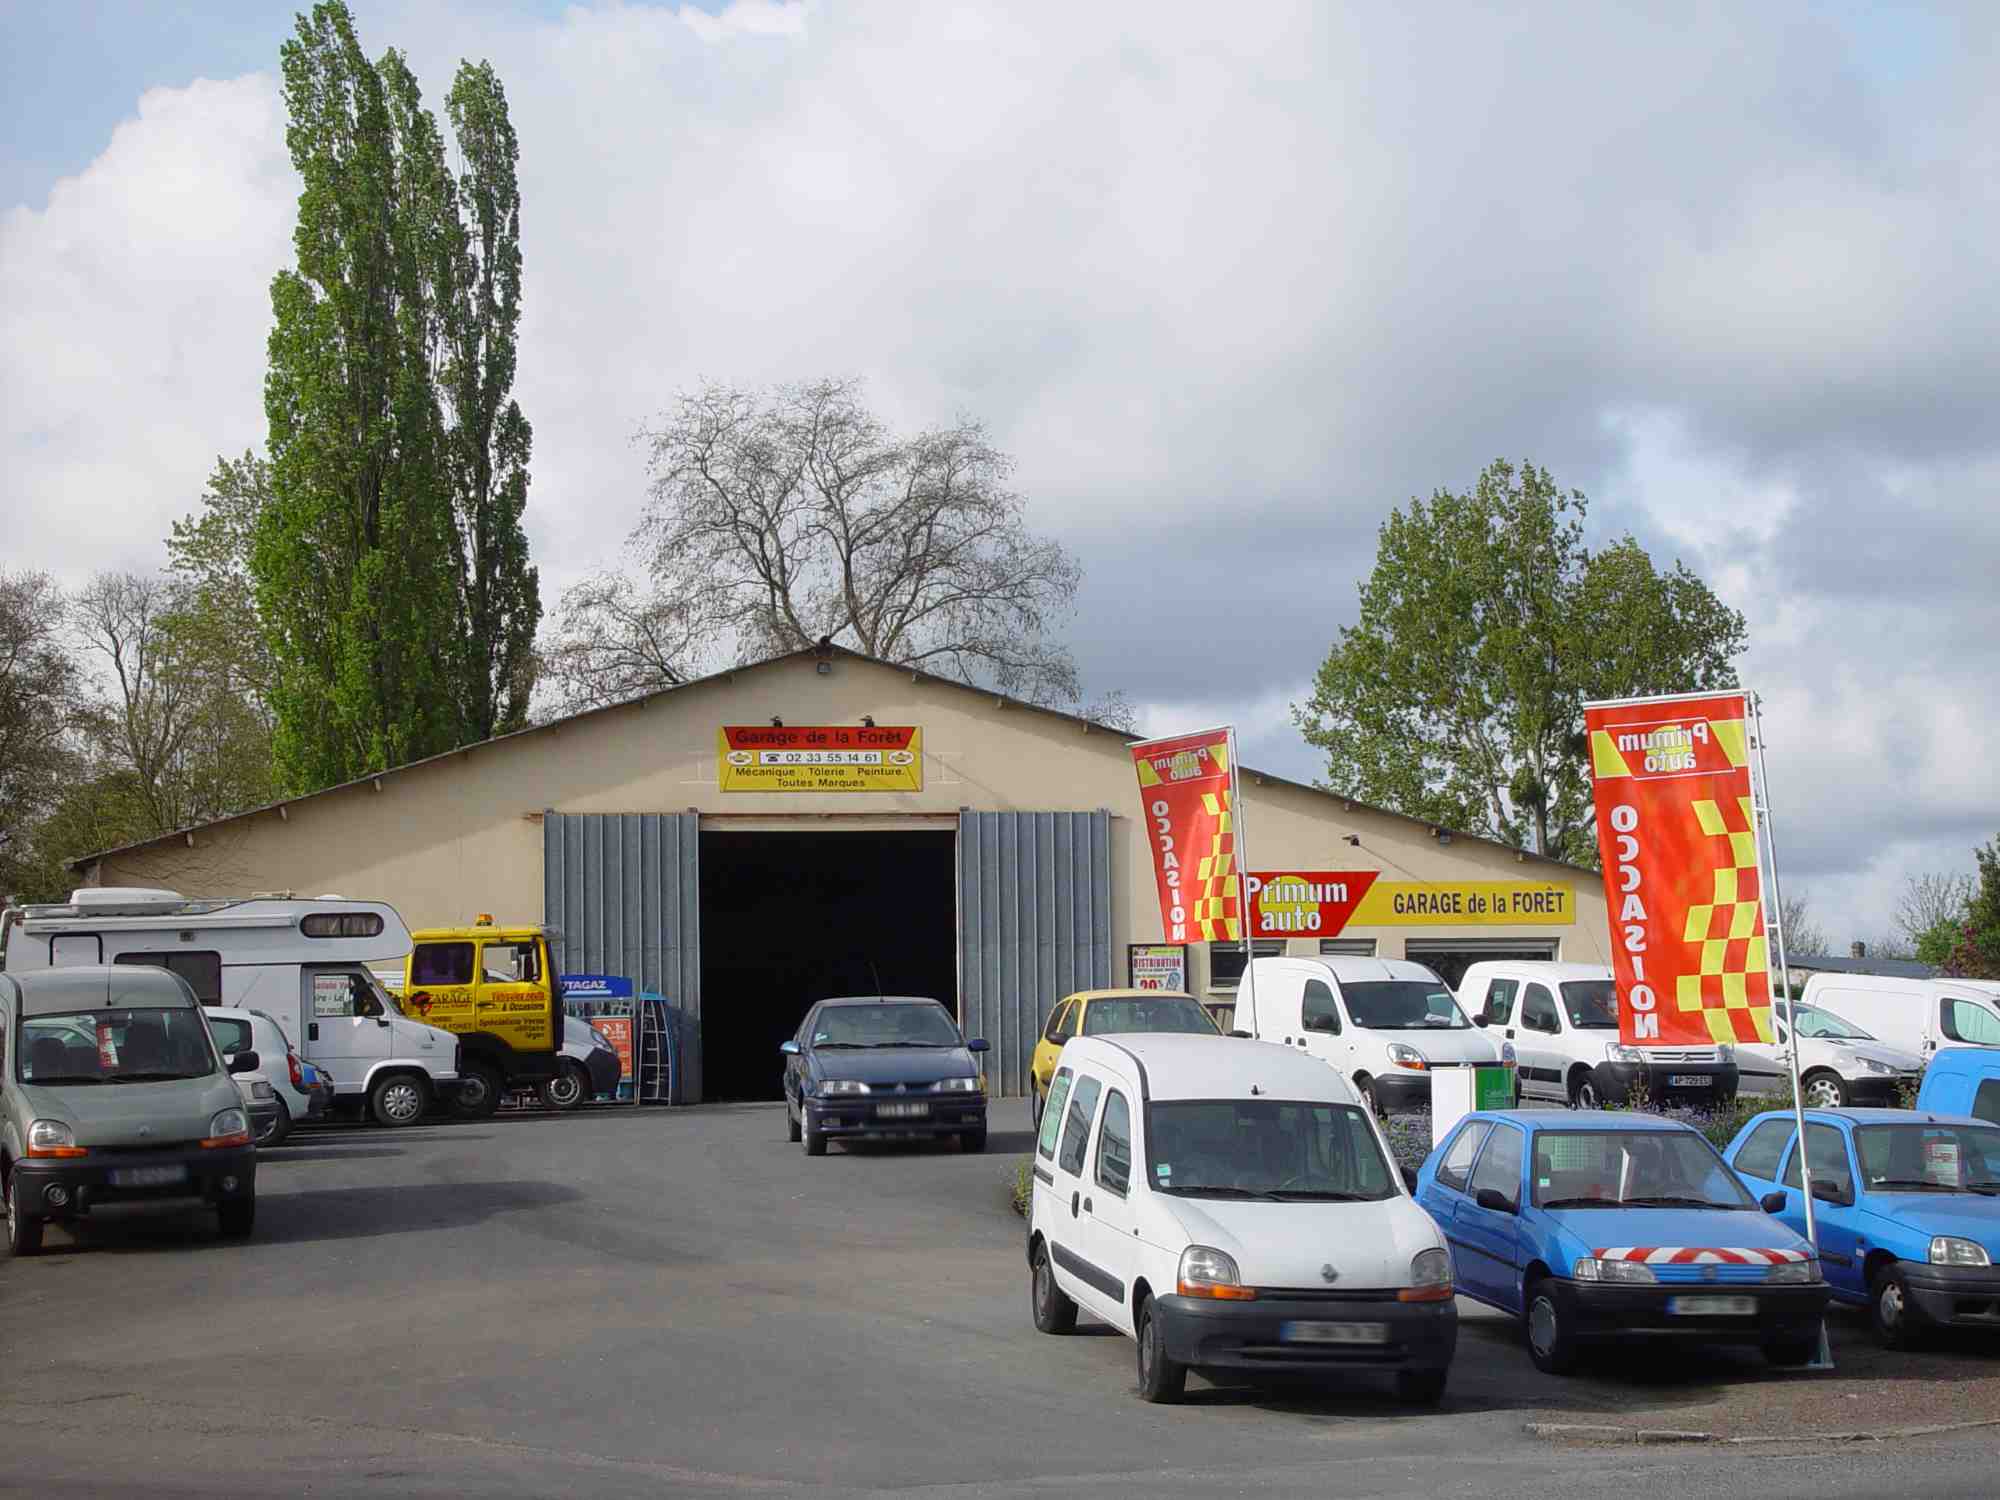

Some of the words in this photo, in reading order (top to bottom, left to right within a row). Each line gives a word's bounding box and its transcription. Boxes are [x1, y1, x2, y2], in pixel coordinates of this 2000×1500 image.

[736, 731, 799, 745] Garage
[806, 731, 826, 743] de
[835, 731, 849, 743] la
[786, 753, 801, 762] 02
[807, 753, 821, 762] 33
[827, 753, 842, 762] 55
[848, 753, 859, 762] 14
[864, 753, 878, 762] 61
[777, 779, 813, 787] Toutes
[818, 779, 865, 788] Marques
[1247, 876, 1348, 903] Primum
[1393, 892, 1462, 914] GARAGE
[1468, 892, 1487, 914] de
[1492, 892, 1506, 914] la
[1512, 886, 1565, 913] FORÊT
[1261, 904, 1321, 931] auto
[560, 980, 608, 990] TAGAZ
